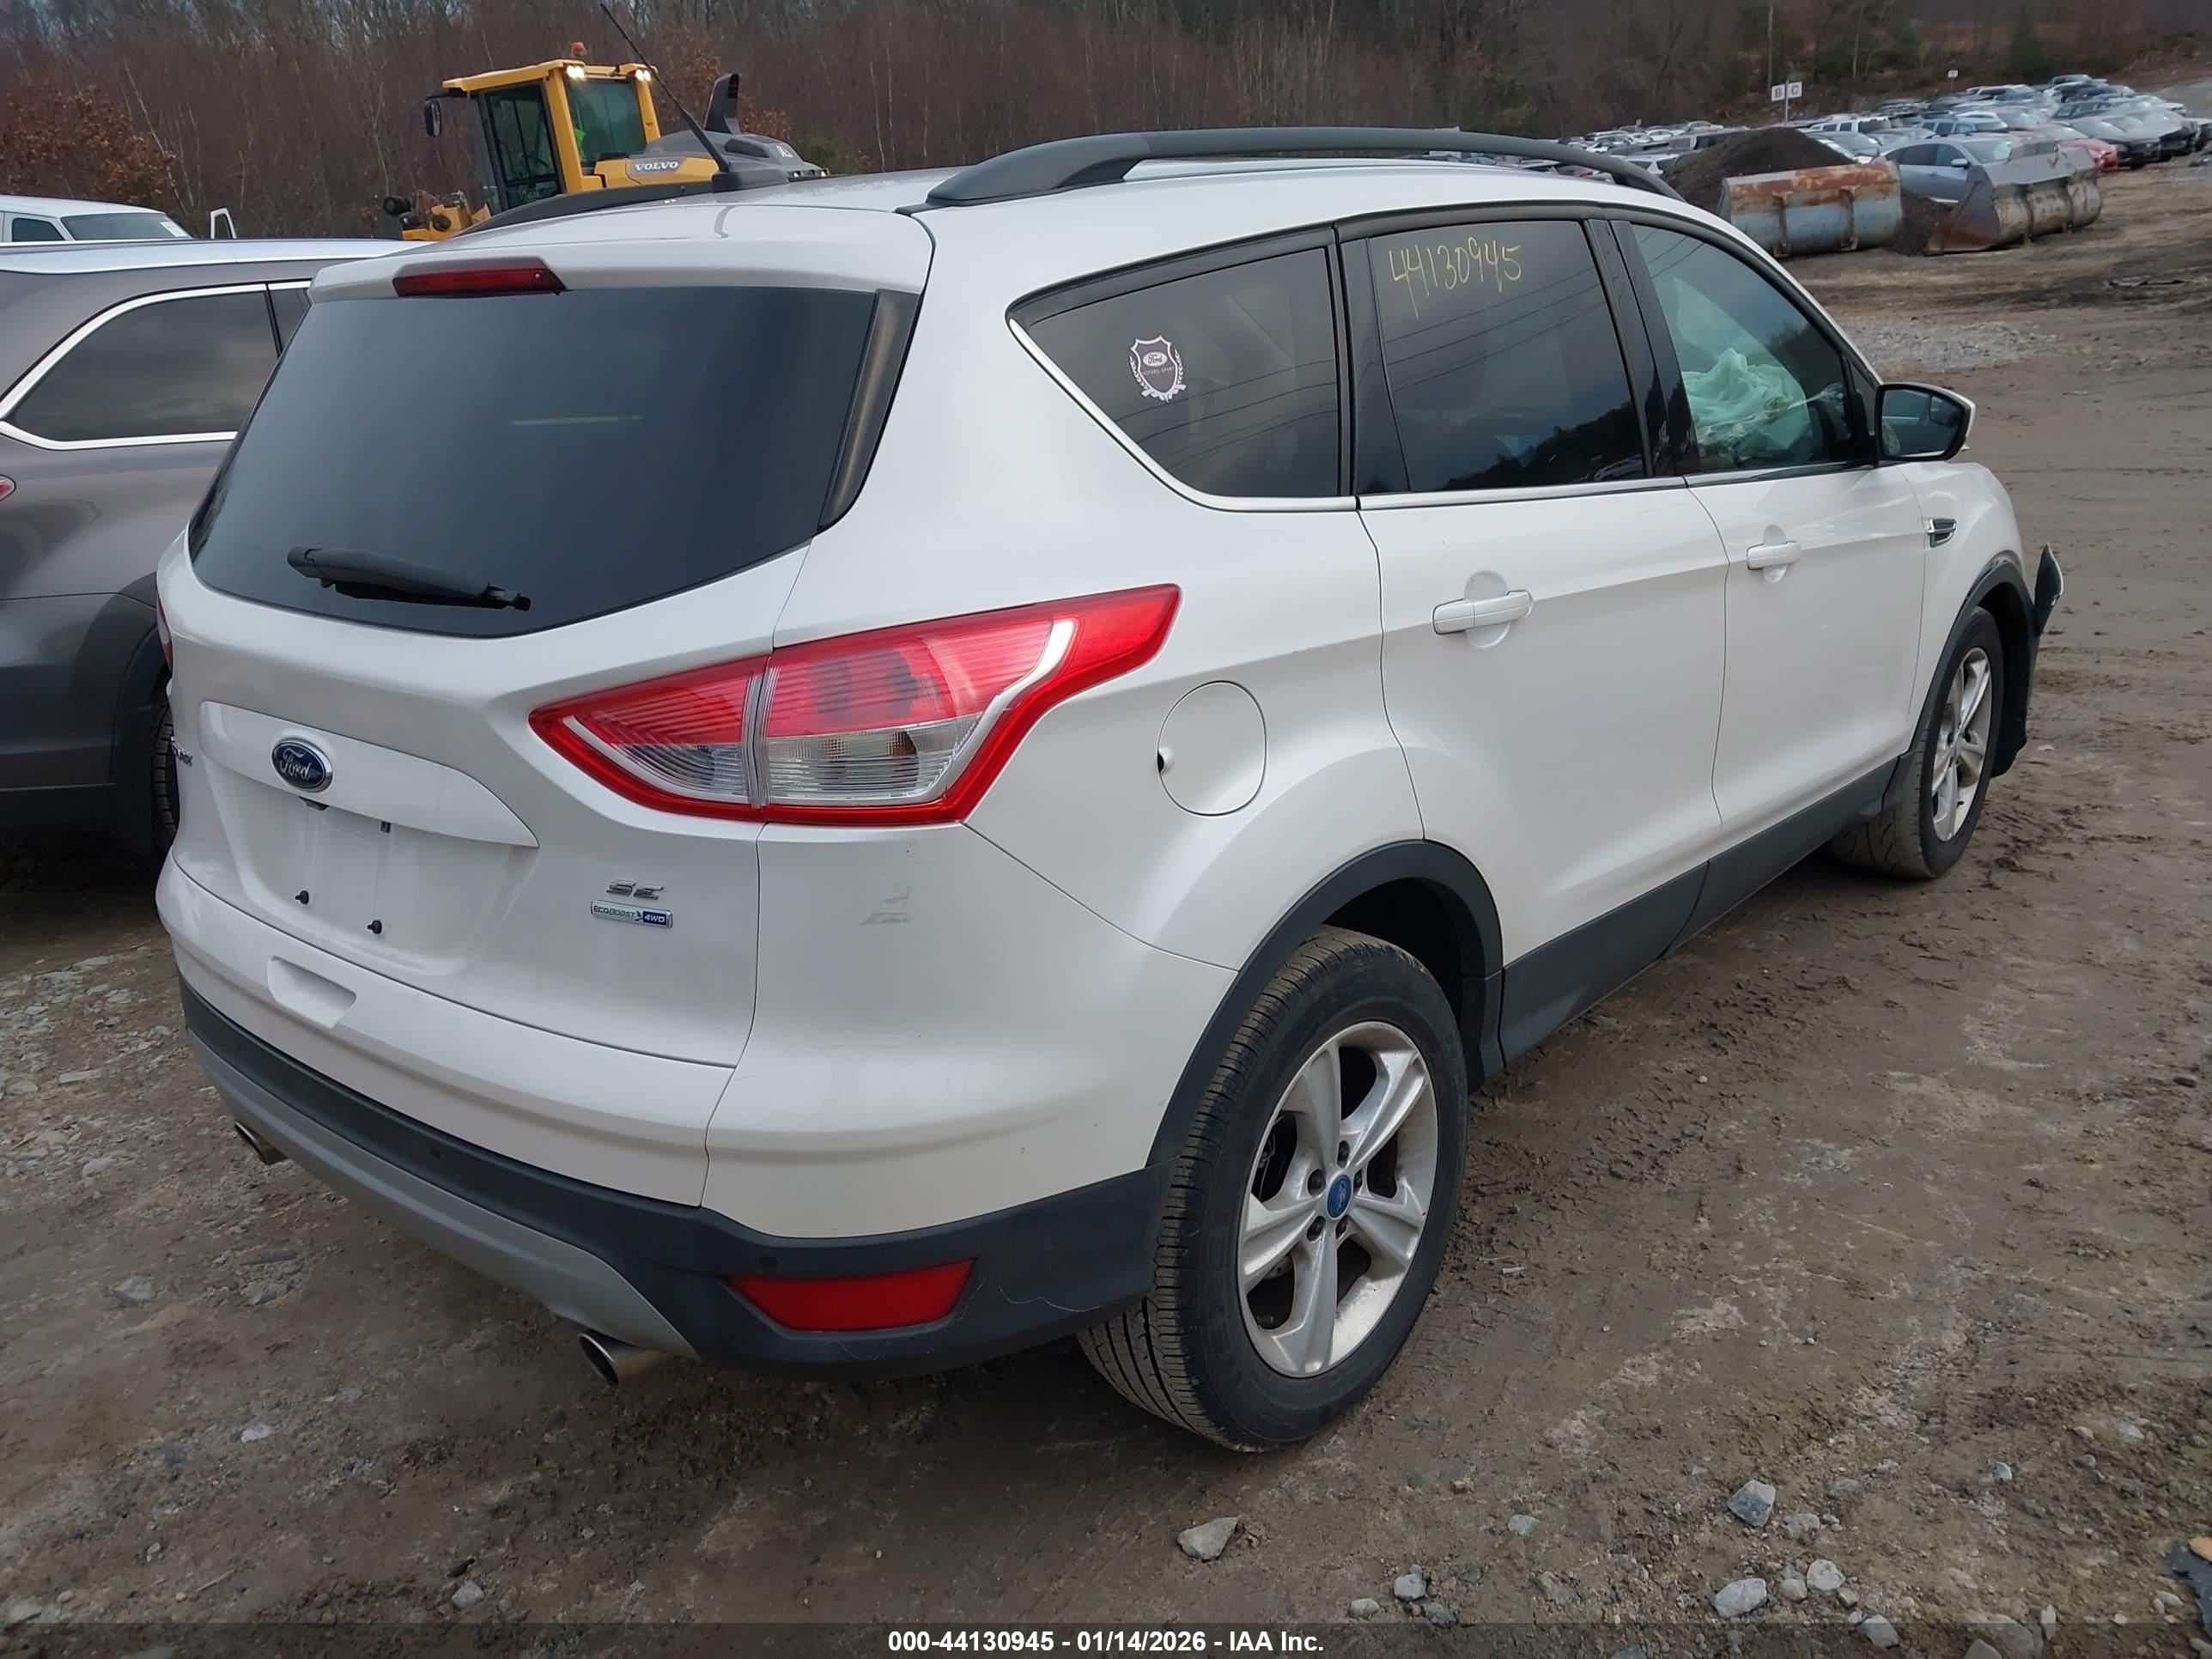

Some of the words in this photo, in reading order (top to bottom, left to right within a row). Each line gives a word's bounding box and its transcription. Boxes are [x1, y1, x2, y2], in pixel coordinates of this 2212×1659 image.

[1775, 88, 1782, 97] B
[1791, 86, 1800, 95] C
[635, 161, 678, 171] VOLVO
[1389, 236, 1522, 319] 44130945
[280, 748, 313, 781] Ford
[606, 879, 664, 900] SE
[644, 914, 665, 923] 4WD
